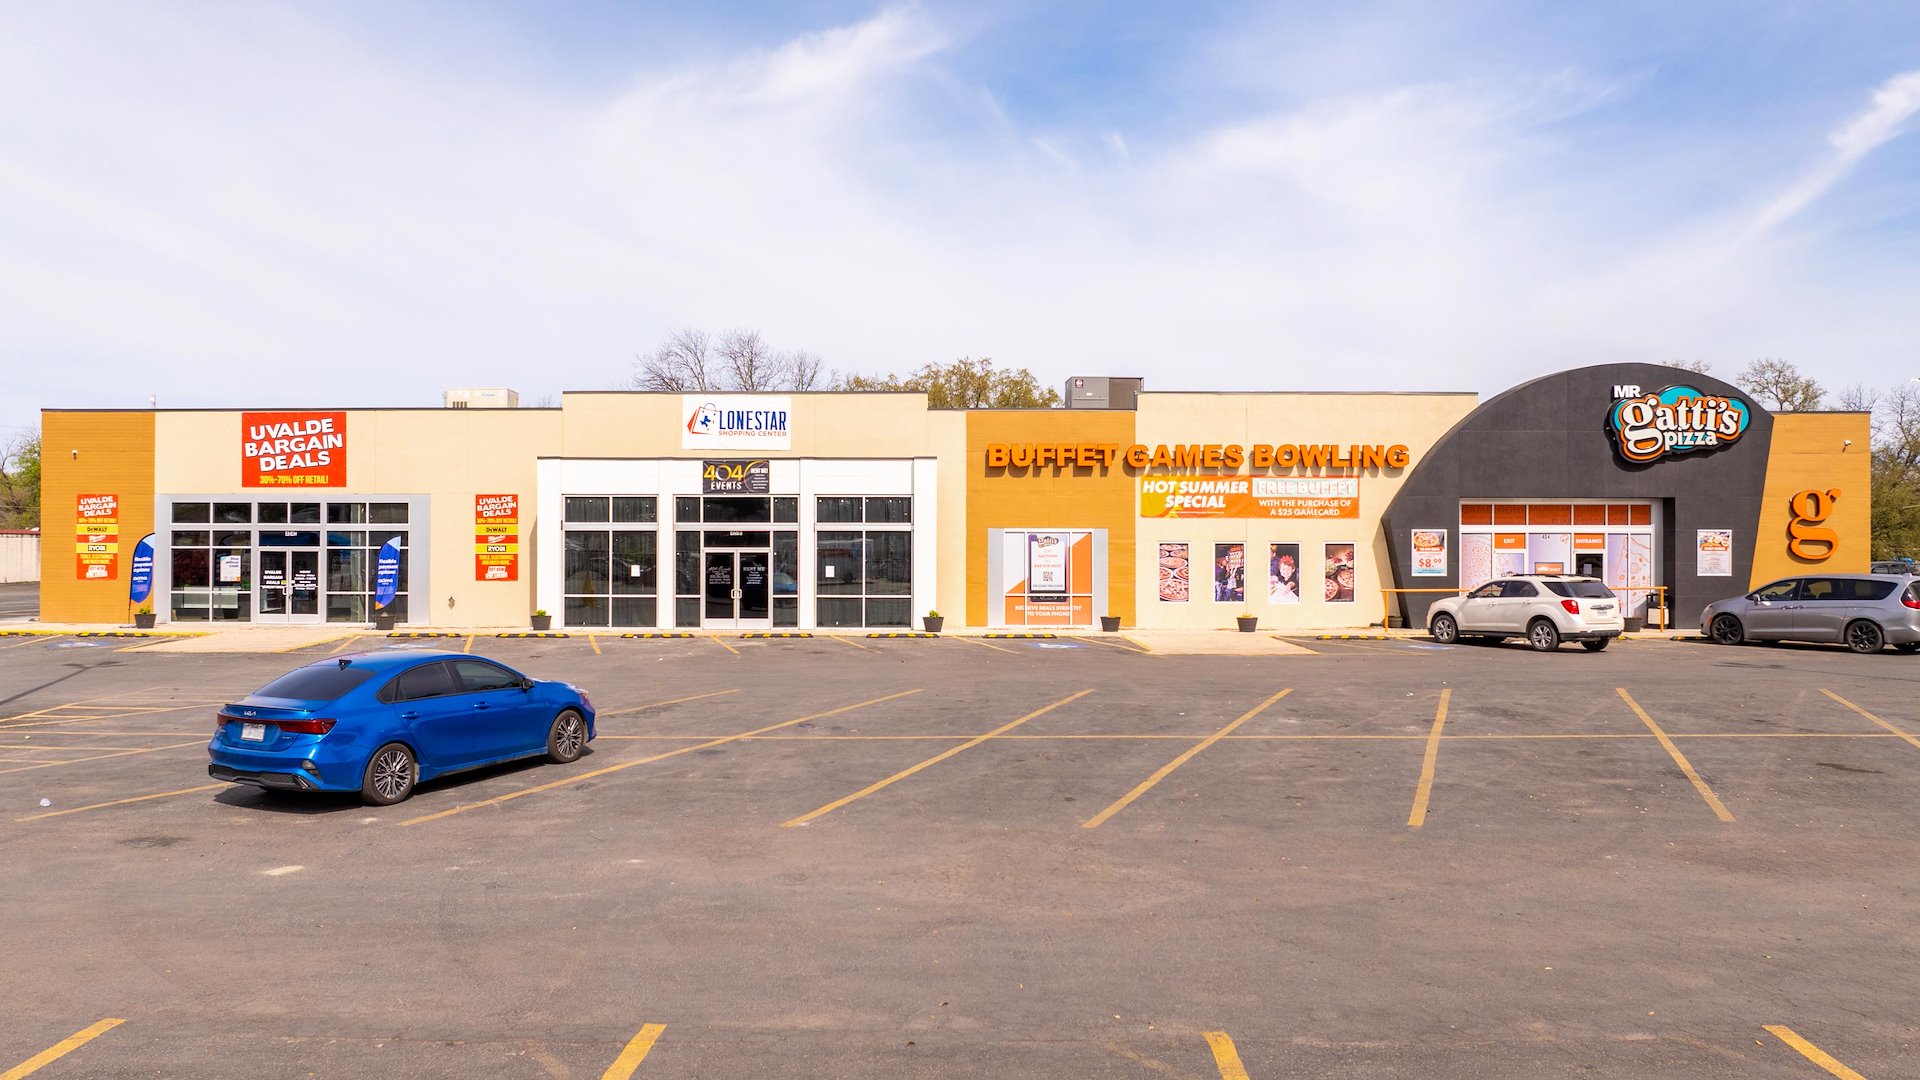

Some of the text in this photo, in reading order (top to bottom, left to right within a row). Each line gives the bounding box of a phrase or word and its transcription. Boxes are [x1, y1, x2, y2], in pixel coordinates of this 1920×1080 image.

[1613, 385, 1641, 398] MR
[719, 410, 787, 431] LONESTAR
[1622, 398, 1739, 454] gatti's
[250, 418, 334, 441] UVALDE
[244, 433, 343, 457] BARGAIN
[1663, 427, 1718, 451] pizza
[259, 451, 331, 472] DEALS
[988, 443, 1410, 468] BUFFET GAMES BOWLING
[260, 475, 328, 484] 30%-70% OFF RETAIL!
[703, 465, 744, 481] 404
[711, 482, 742, 491] EVENTS
[1142, 480, 1249, 494] HOT SUMMER
[1257, 480, 1354, 495] FREE BUFFET
[78, 502, 117, 511] BARGAIN
[80, 496, 113, 505] UVALDE
[477, 502, 517, 511] BARGAIN
[479, 496, 513, 505] UVALDE
[1165, 495, 1226, 508] SPECIAL
[1259, 499, 1280, 507] WITH
[1281, 499, 1295, 507] THE
[84, 509, 112, 517] DEALS
[483, 509, 512, 517] DEALS
[1270, 508, 1340, 517] A $25 GAMECARD
[1790, 488, 1842, 560] g
